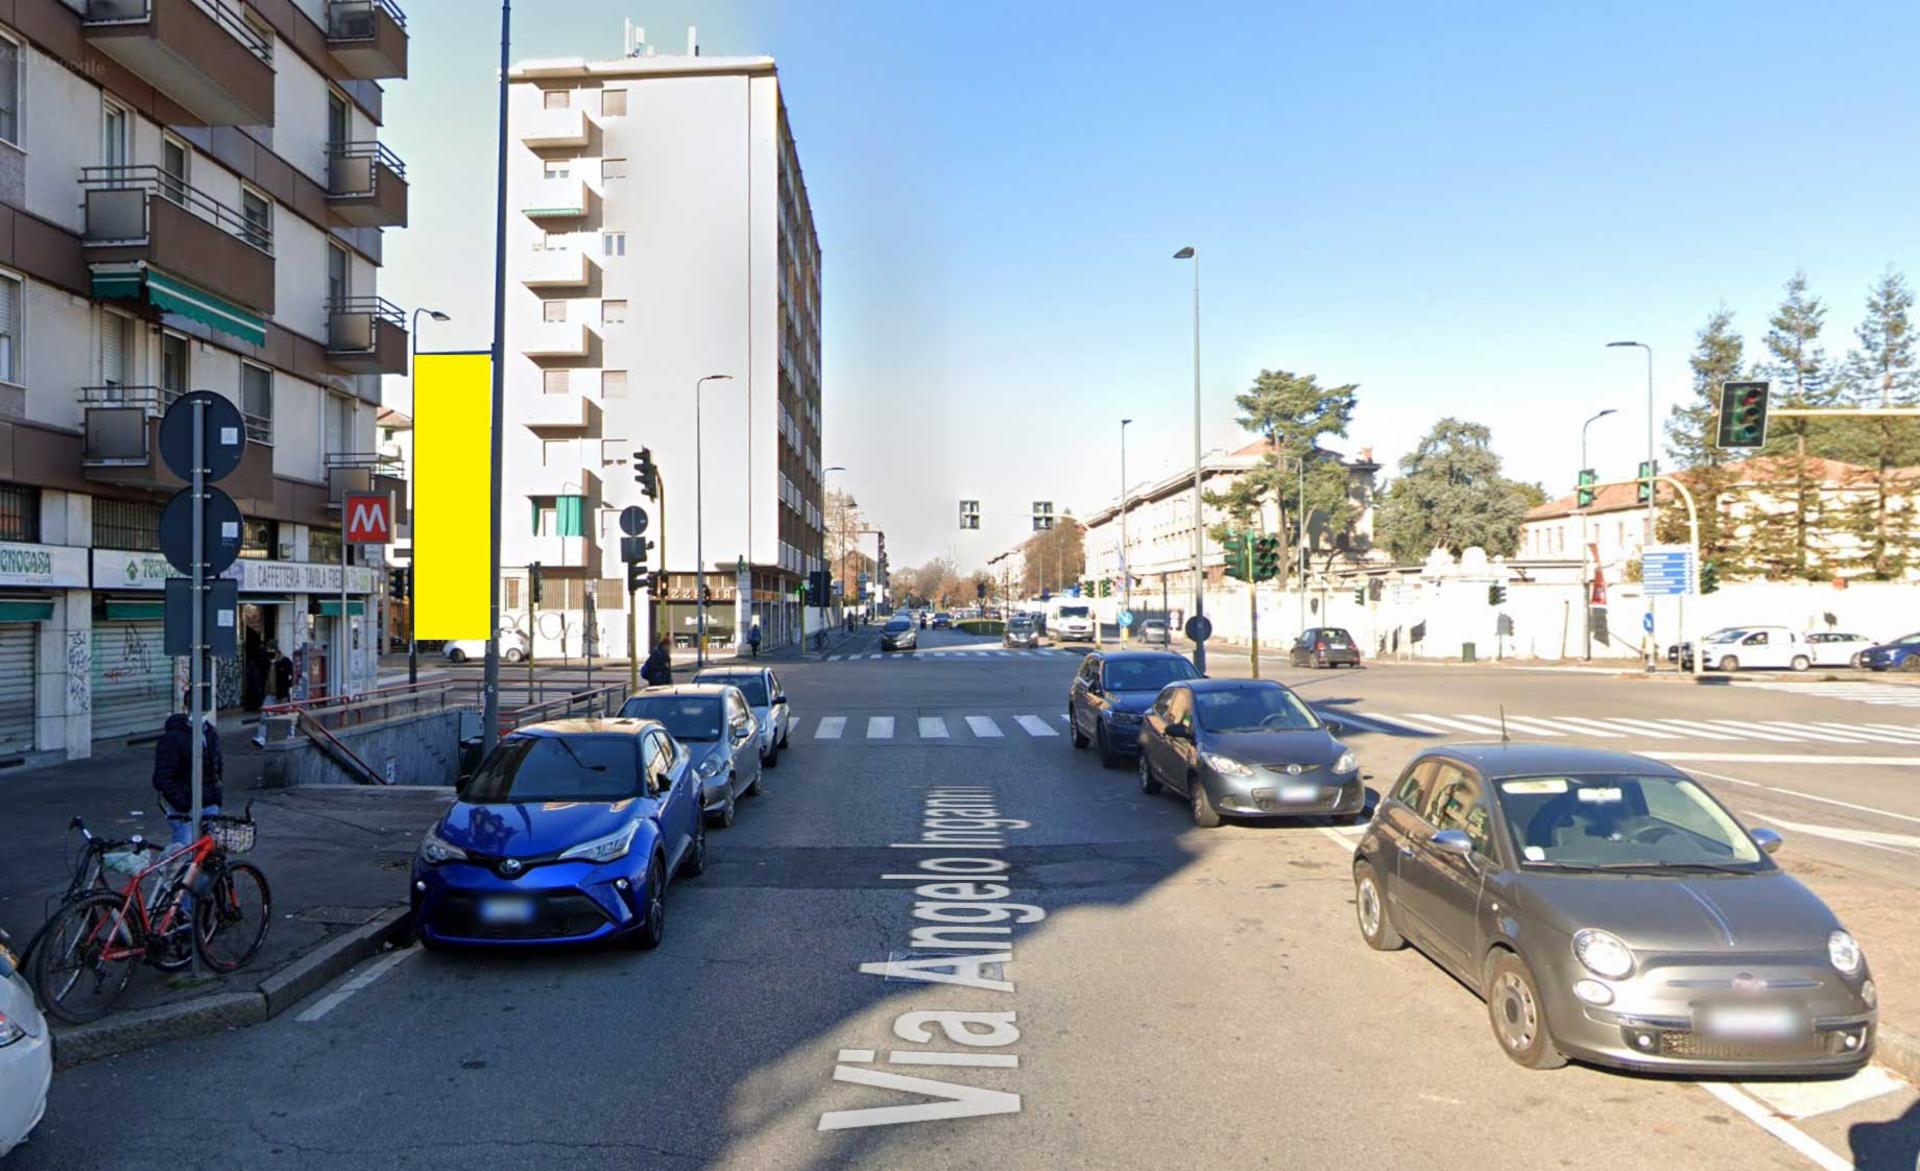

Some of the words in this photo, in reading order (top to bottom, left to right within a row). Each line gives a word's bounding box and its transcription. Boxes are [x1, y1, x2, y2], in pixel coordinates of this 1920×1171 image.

[350, 504, 386, 532] M
[258, 565, 299, 588] CAFFETTERIA
[305, 567, 326, 588] TAVOLA
